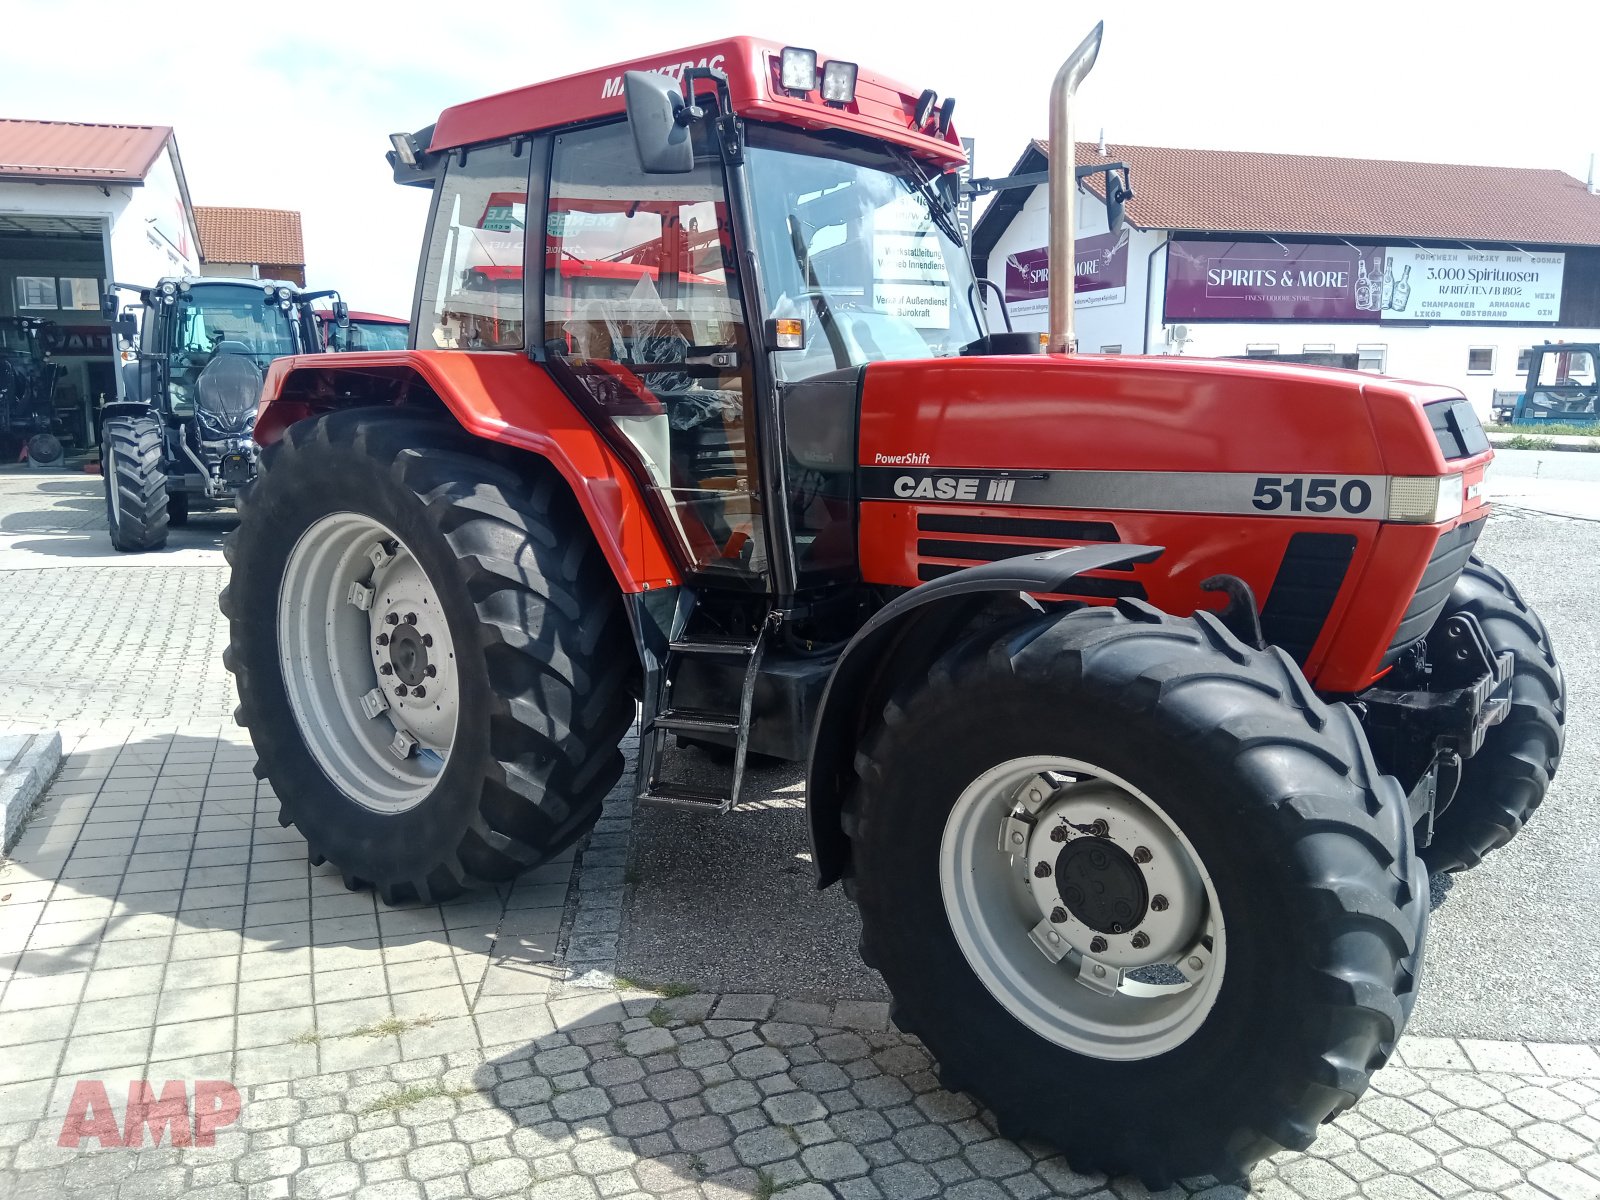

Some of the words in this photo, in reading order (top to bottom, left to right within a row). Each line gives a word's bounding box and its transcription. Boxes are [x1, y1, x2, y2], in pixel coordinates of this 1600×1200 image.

[1415, 253, 1458, 261] PORTWEIN
[1467, 254, 1499, 262] WHISKY
[1207, 269, 1277, 287] SPIRITS
[1280, 270, 1294, 287] &
[1297, 271, 1348, 288] MORE
[1427, 267, 1465, 280] 3.000
[1467, 268, 1539, 283] Spirituosen
[1414, 309, 1441, 317] LIKÖR
[875, 452, 930, 464] PowerShift
[893, 476, 980, 500] CASE
[1251, 477, 1372, 514] 5150
